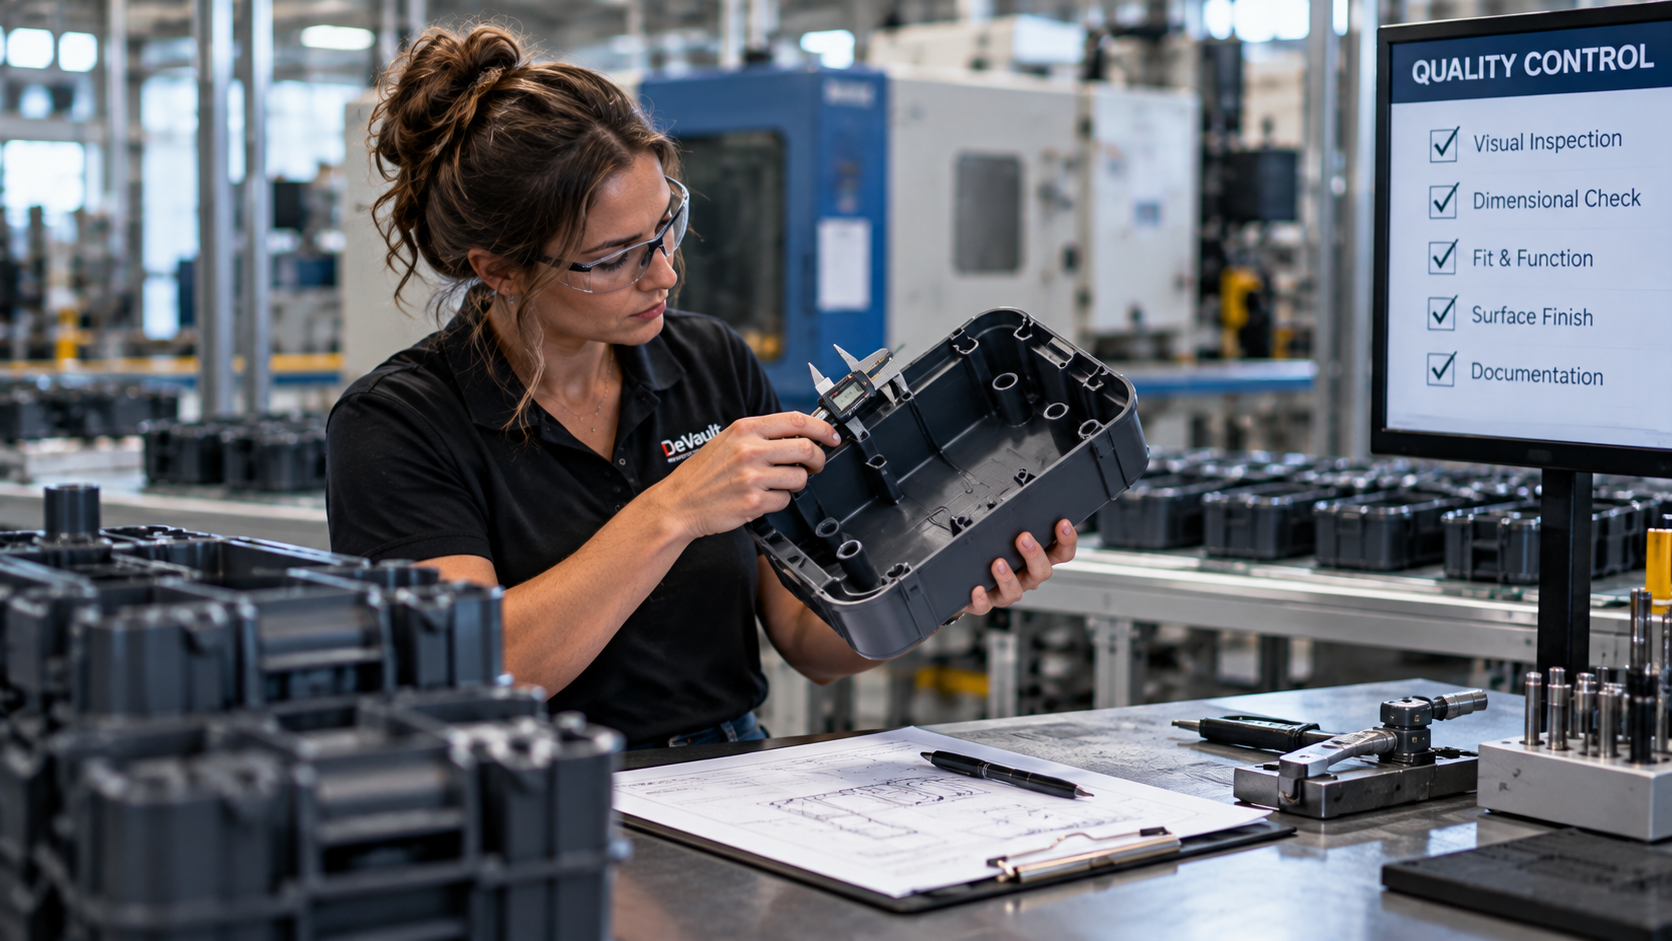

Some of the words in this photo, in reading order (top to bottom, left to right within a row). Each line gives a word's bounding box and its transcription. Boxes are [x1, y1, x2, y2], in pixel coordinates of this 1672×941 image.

[1411, 53, 1518, 86] QUALITY
[1523, 42, 1655, 77] CONTROL
[1473, 132, 1524, 153] Visual
[1530, 128, 1623, 154] Inspection
[1473, 188, 1579, 210] Dimensional
[1584, 187, 1642, 208] Check
[1473, 248, 1494, 268] Fit
[1499, 248, 1512, 268] &
[1517, 248, 1594, 268] Function
[1472, 305, 1537, 326] Surface
[1542, 307, 1594, 327] Finish
[1471, 361, 1604, 387] Documentation
[661, 423, 721, 457] DeVault
